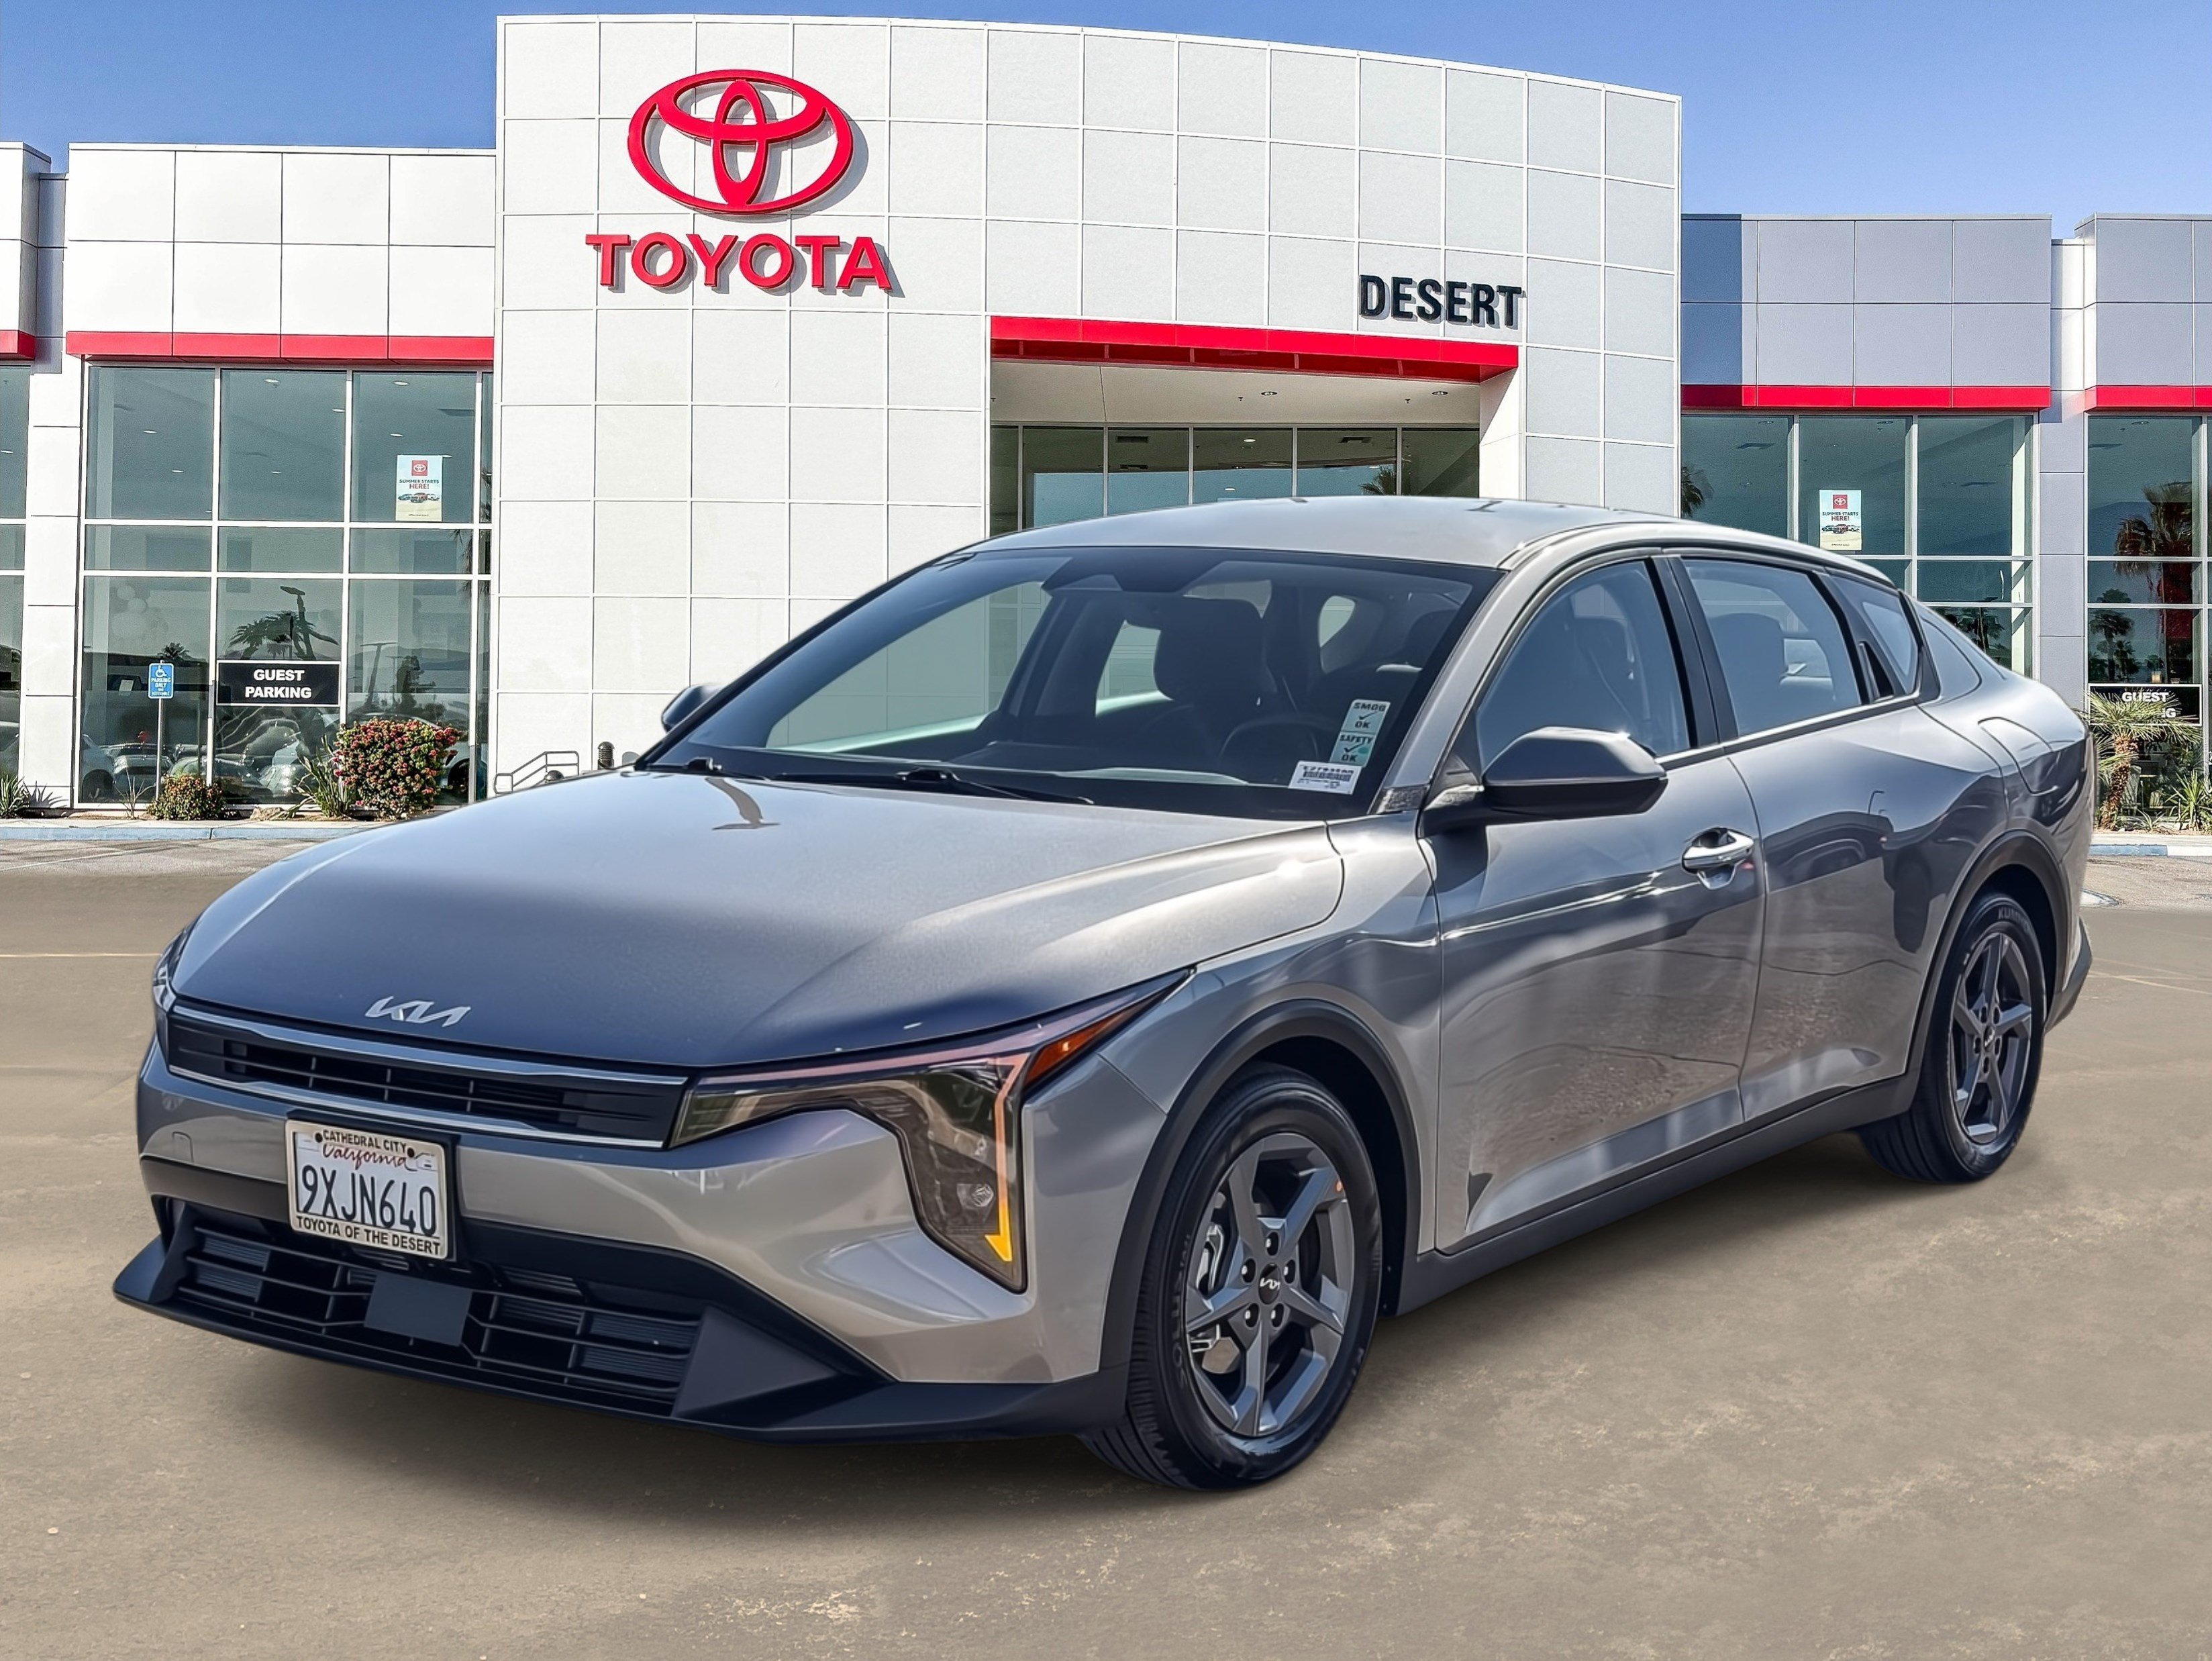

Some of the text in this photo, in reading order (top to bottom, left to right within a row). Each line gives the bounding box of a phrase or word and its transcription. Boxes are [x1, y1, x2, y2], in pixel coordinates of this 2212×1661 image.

[585, 232, 893, 291] TOYOTA
[1358, 274, 1523, 327] DESERT
[253, 669, 305, 681] GUEST
[245, 686, 311, 699] PARKING
[2121, 691, 2169, 702] GUEST
[1353, 703, 1387, 711] SMOG
[1355, 721, 1370, 729] OK
[1340, 734, 1374, 744] SAFETY
[364, 995, 471, 1027] KIA
[323, 1129, 407, 1154] CATHEDRAL CITY
[322, 1144, 410, 1170] California
[302, 1164, 436, 1237] 9XJN640
[296, 1215, 441, 1256] TOYOTA OF THE DESERT
